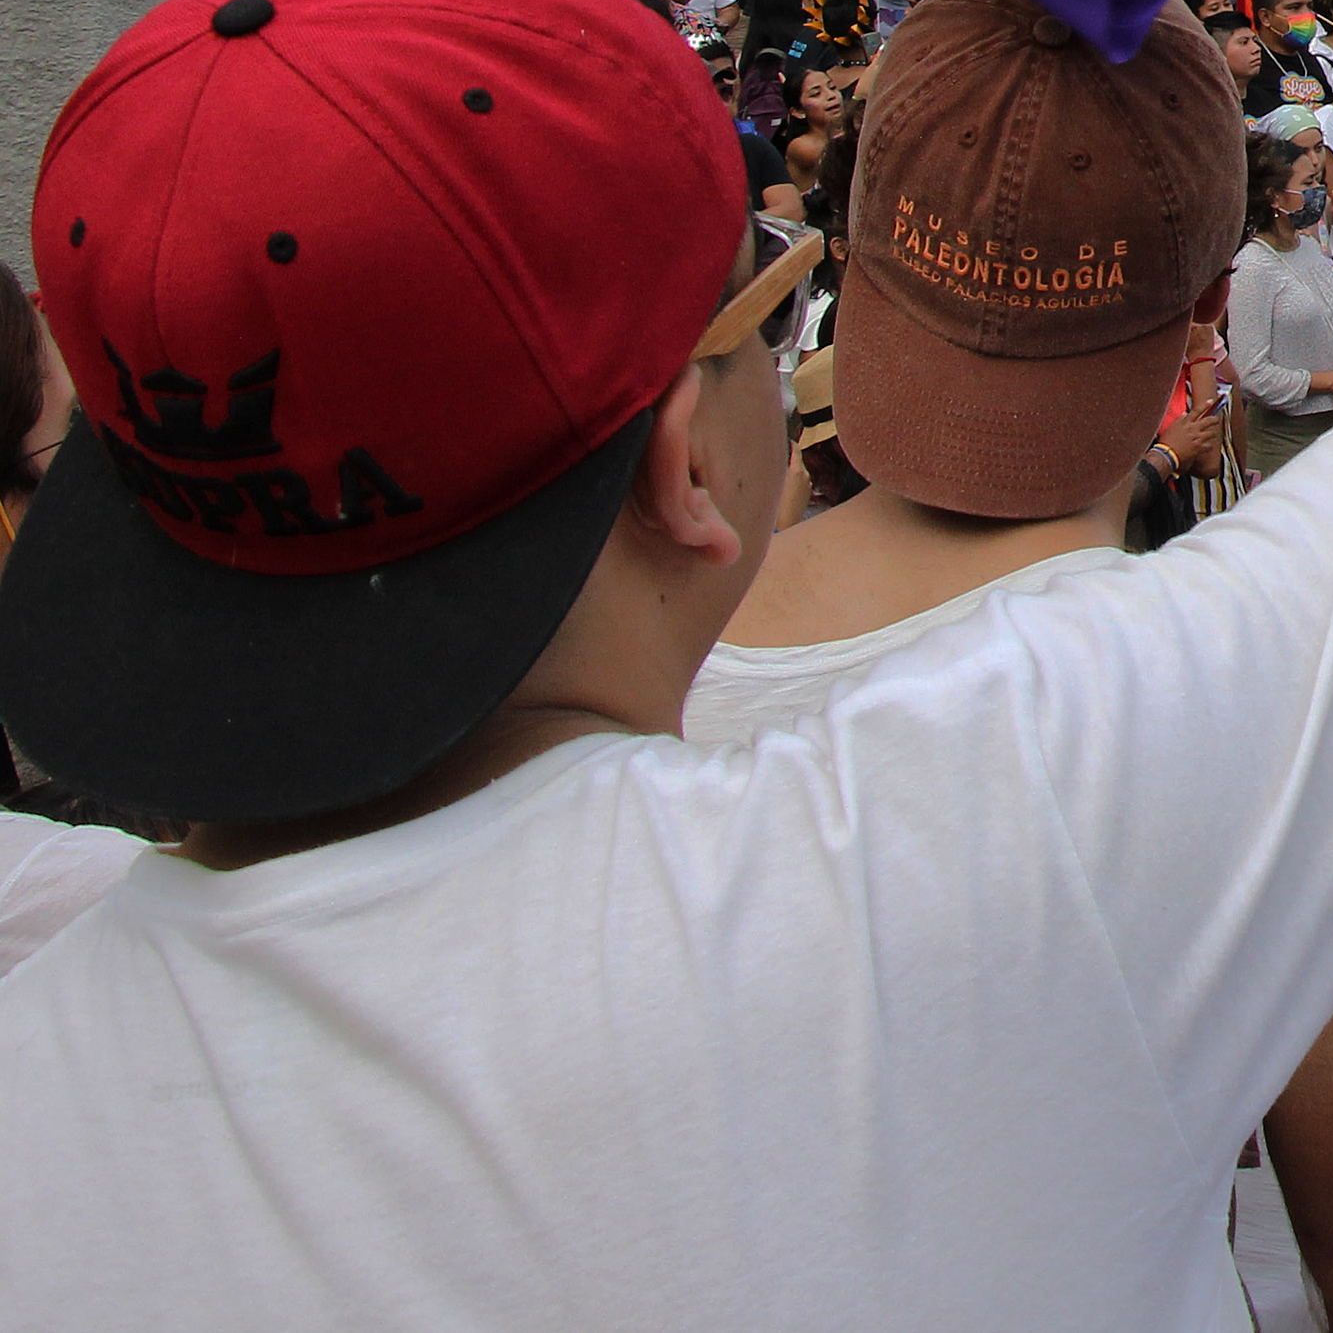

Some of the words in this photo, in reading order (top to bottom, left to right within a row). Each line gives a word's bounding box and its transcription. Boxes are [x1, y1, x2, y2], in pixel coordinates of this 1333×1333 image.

[1284, 77, 1322, 98] Love
[898, 194, 1040, 261] MUSEO
[1078, 239, 1129, 260] DE
[893, 215, 1125, 293] PALEONTOLOGÍA
[1035, 290, 1124, 310] AGUILERA
